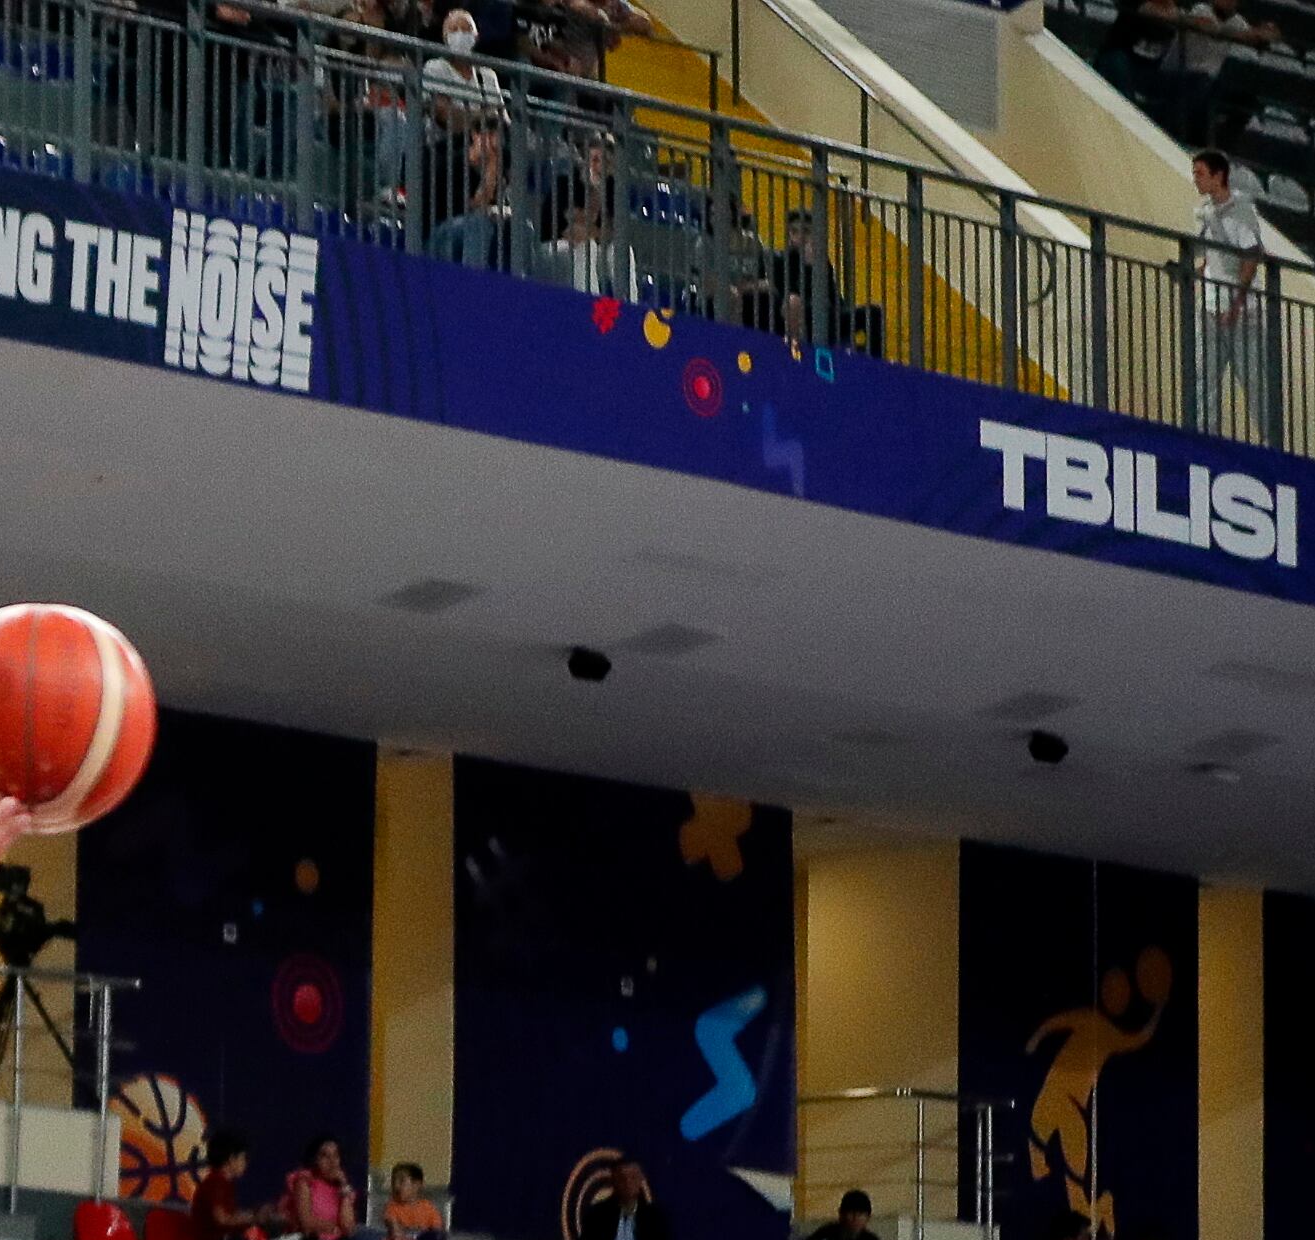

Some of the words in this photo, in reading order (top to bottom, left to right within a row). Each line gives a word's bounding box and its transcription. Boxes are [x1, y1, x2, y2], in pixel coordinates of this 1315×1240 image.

[64, 218, 163, 327] THE
[164, 207, 319, 391] NOISE
[979, 417, 1298, 568] TBILISI
